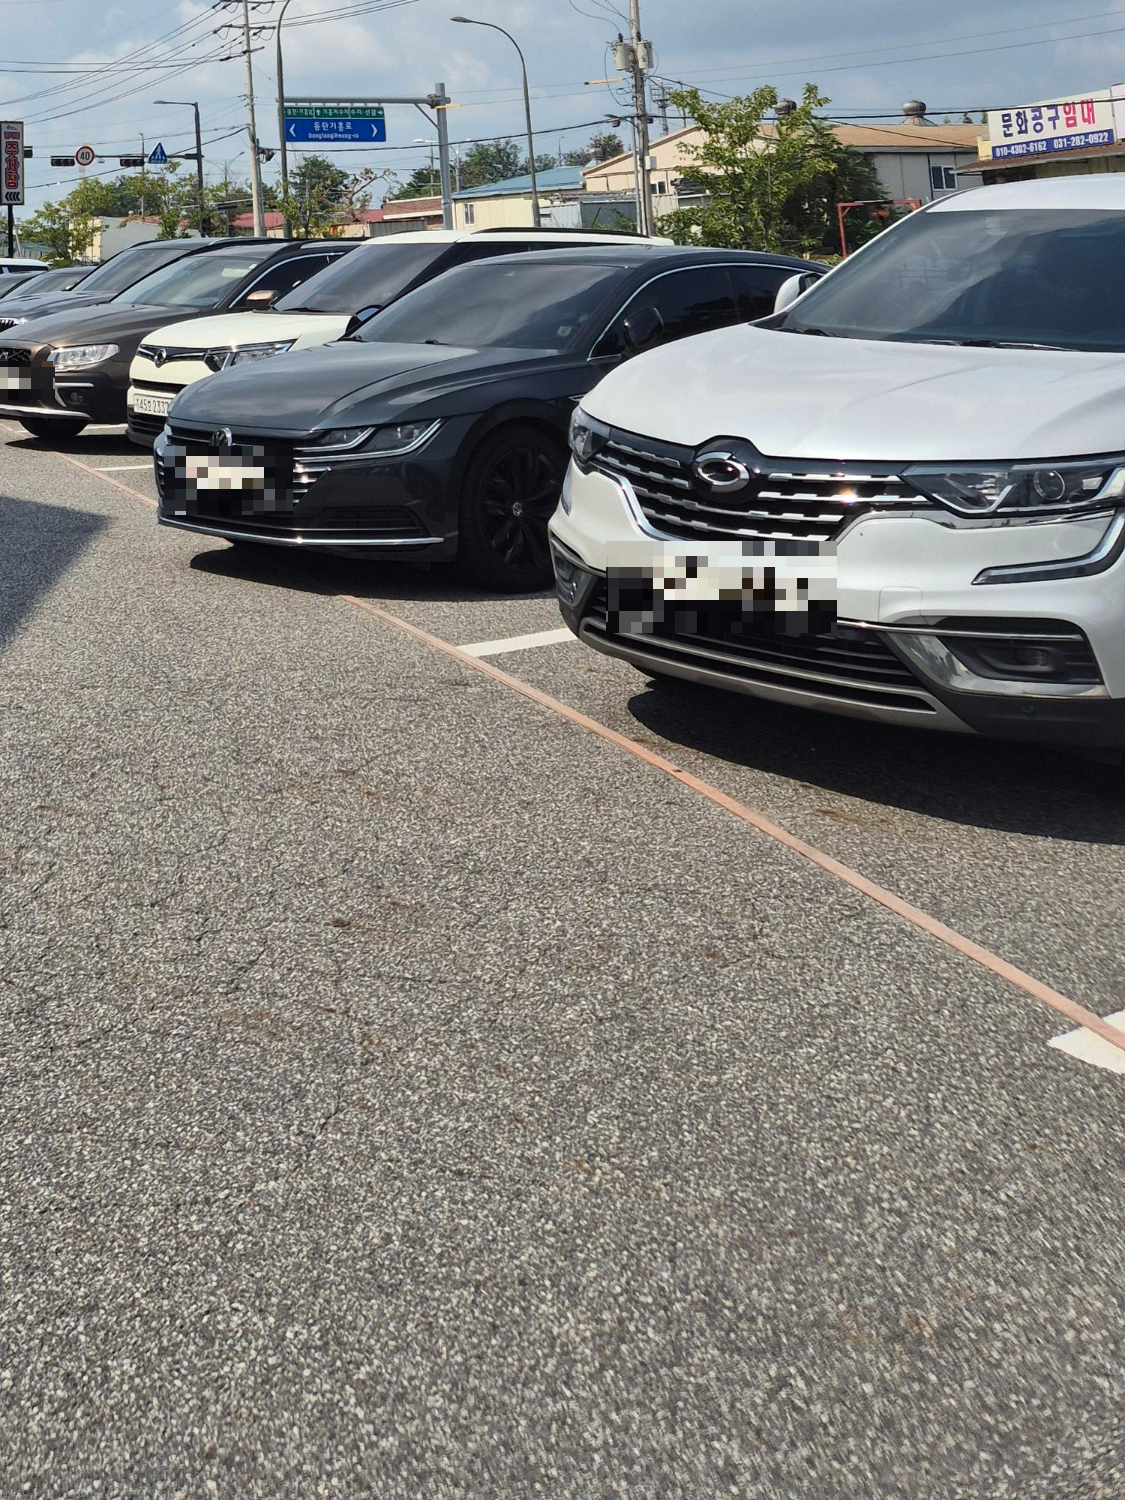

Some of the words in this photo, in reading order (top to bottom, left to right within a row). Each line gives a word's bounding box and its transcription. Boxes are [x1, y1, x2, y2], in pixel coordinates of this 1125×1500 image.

[313, 121, 353, 132] 동탄기흥로
[995, 141, 1047, 157] 010-4302-6162
[1053, 132, 1109, 149] 031-282-0922
[5, 141, 20, 189] 주차장
[80, 151, 91, 161] 40
